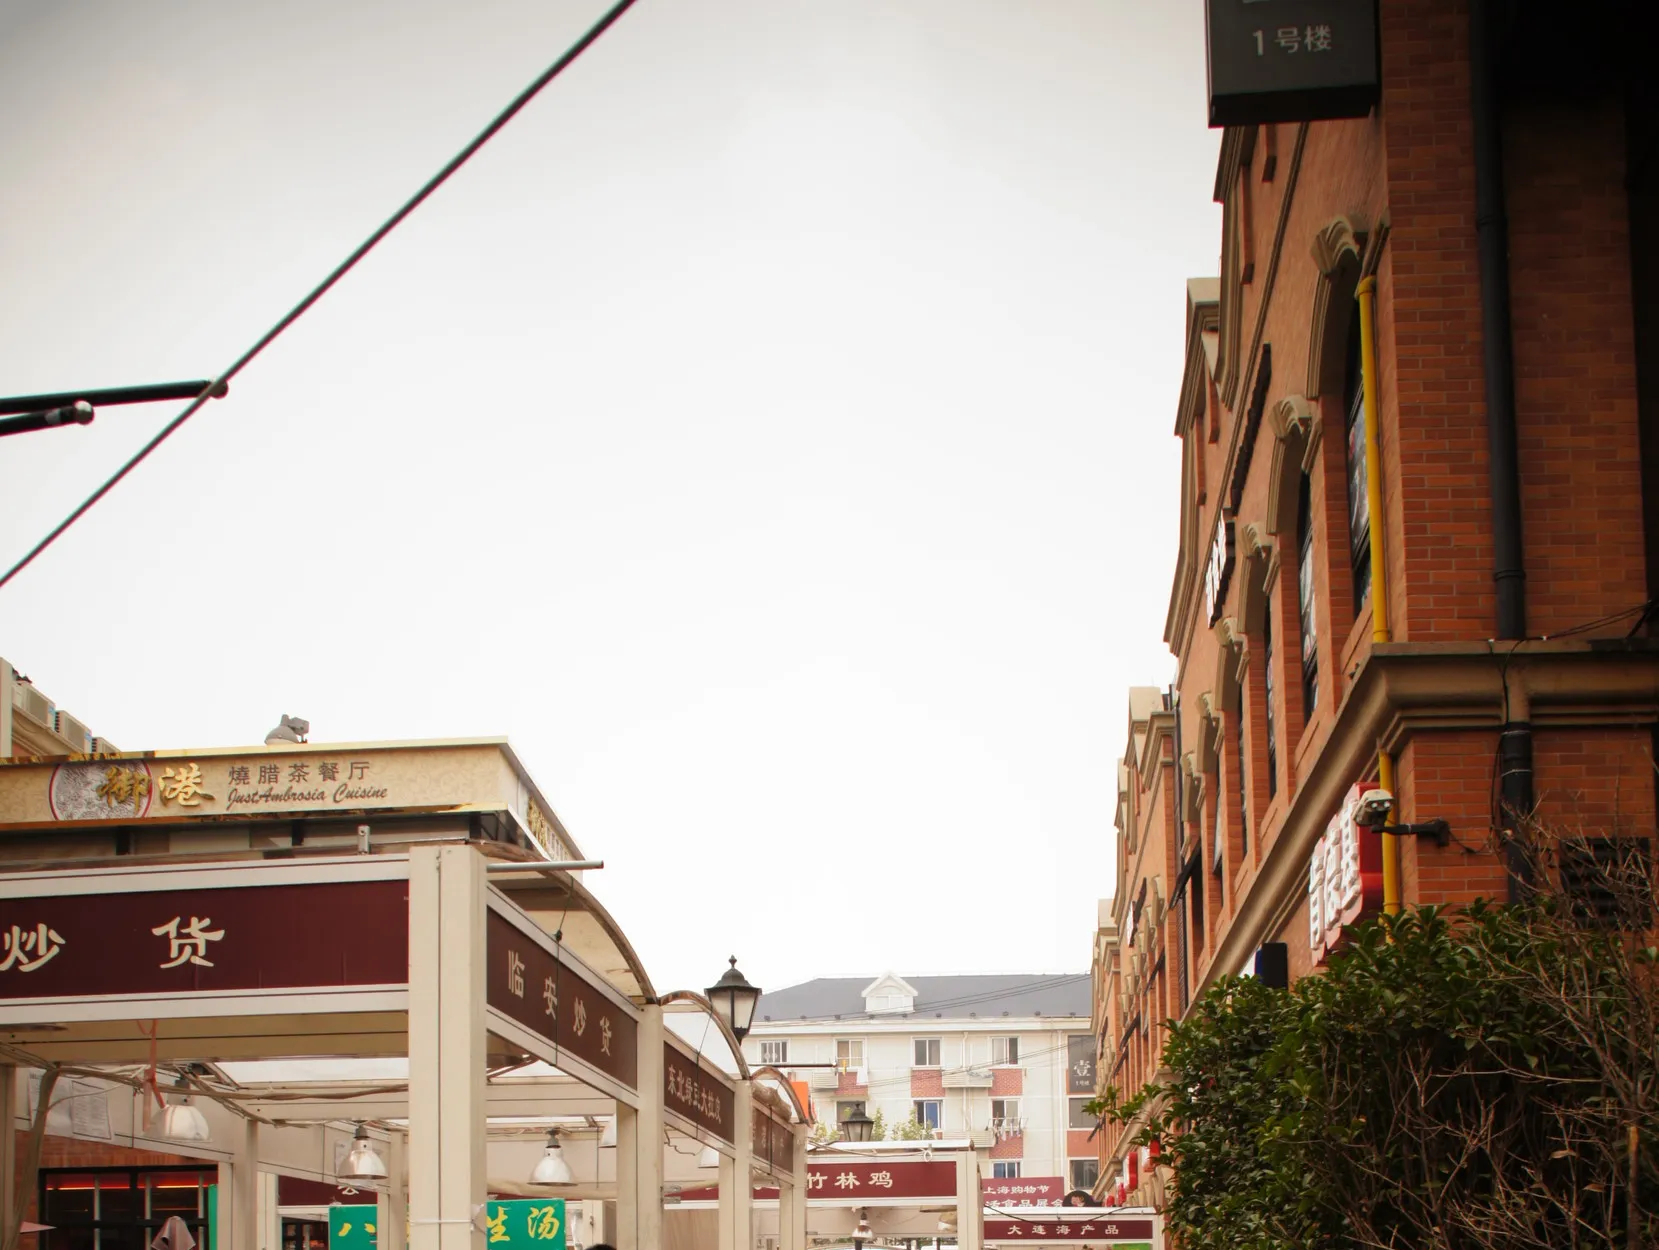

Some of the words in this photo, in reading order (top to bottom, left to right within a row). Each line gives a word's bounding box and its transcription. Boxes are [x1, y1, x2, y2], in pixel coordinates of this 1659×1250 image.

[1252, 24, 1332, 56] 1号楼
[332, 783, 389, 803] Cuisine
[508, 950, 612, 1056] 临安炒货
[806, 1170, 894, 1189] 竹林鸡
[983, 1184, 1051, 1195] 上海购物节
[1007, 1224, 1119, 1236] 大连海产品
